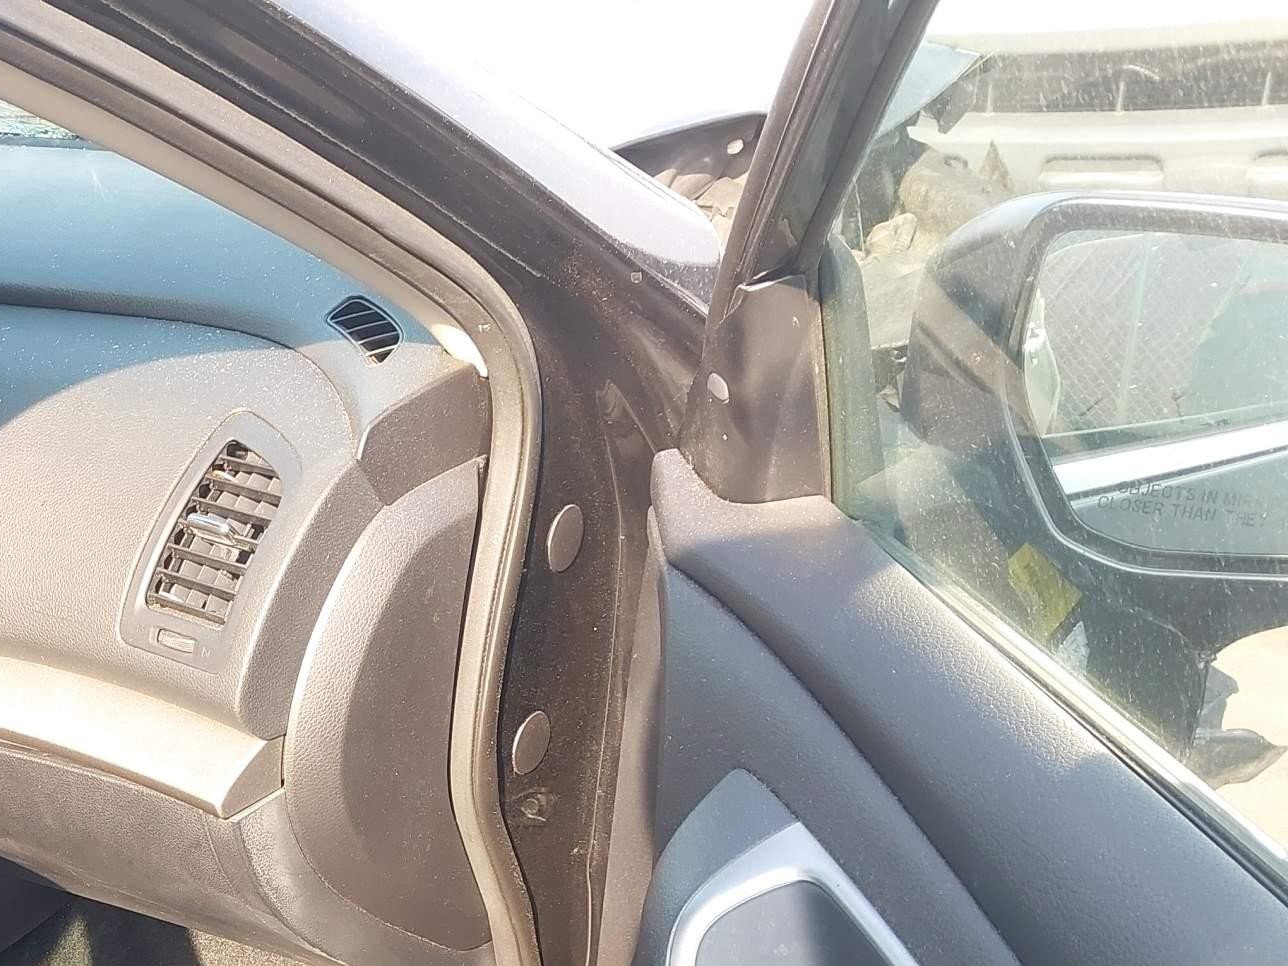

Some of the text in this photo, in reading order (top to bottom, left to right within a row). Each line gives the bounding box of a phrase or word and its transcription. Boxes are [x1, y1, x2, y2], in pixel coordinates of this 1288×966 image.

[1118, 482, 1194, 501] OBJECTS
[1201, 488, 1218, 505] IN
[1097, 495, 1164, 516] CLOSER
[1171, 503, 1217, 521] THAN
